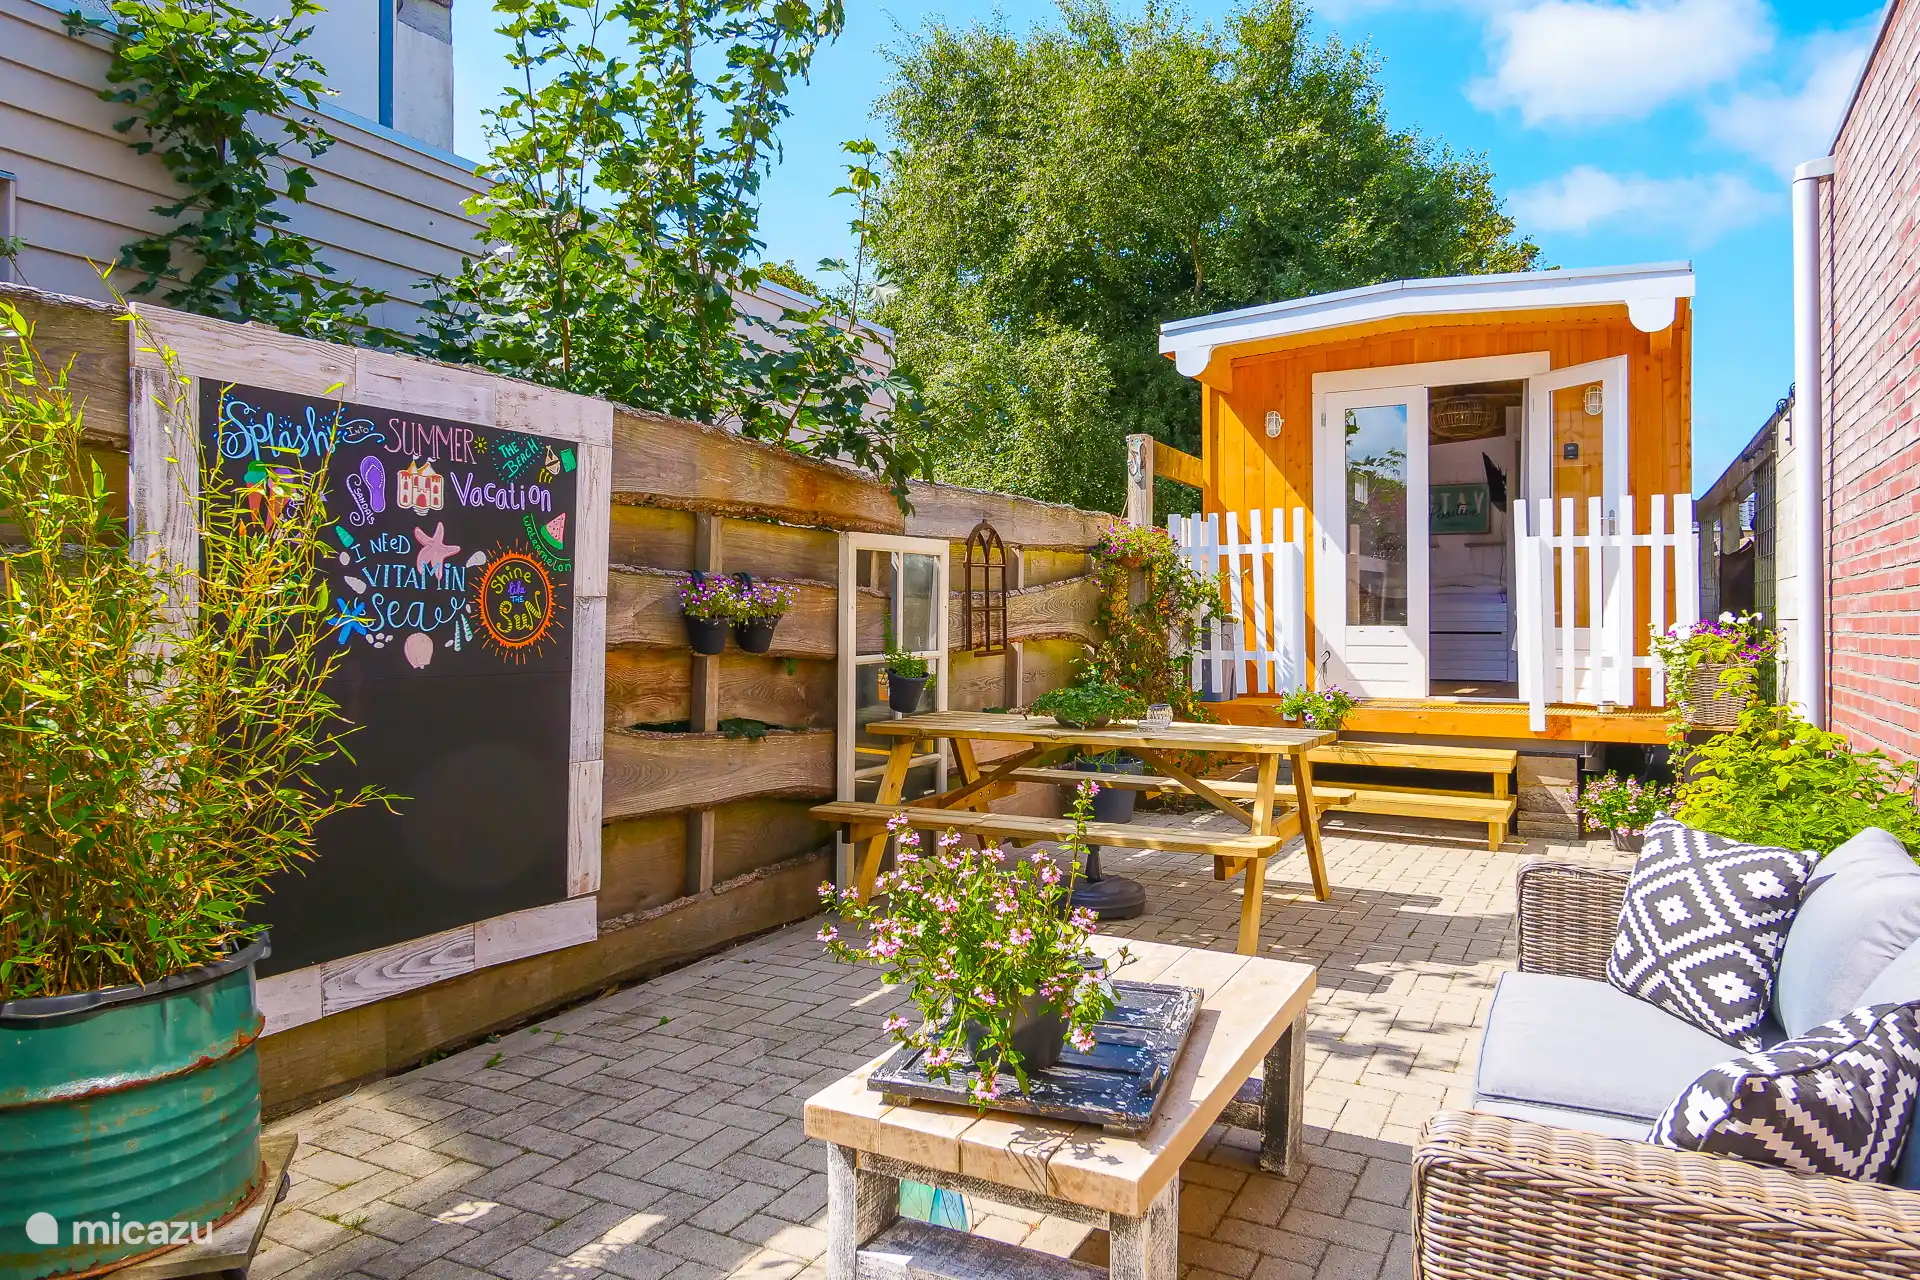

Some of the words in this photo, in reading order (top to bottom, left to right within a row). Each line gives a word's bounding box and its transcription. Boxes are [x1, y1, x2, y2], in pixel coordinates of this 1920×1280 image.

[217, 400, 336, 461] Splash
[384, 418, 478, 465] SUMMER
[499, 441, 518, 459] THE
[503, 438, 539, 477] BEACH
[450, 472, 552, 512] Vacation
[1430, 491, 1484, 515] TAY
[351, 544, 366, 563] I
[490, 565, 532, 595] Shine
[507, 580, 526, 595] like
[510, 595, 525, 603] THE
